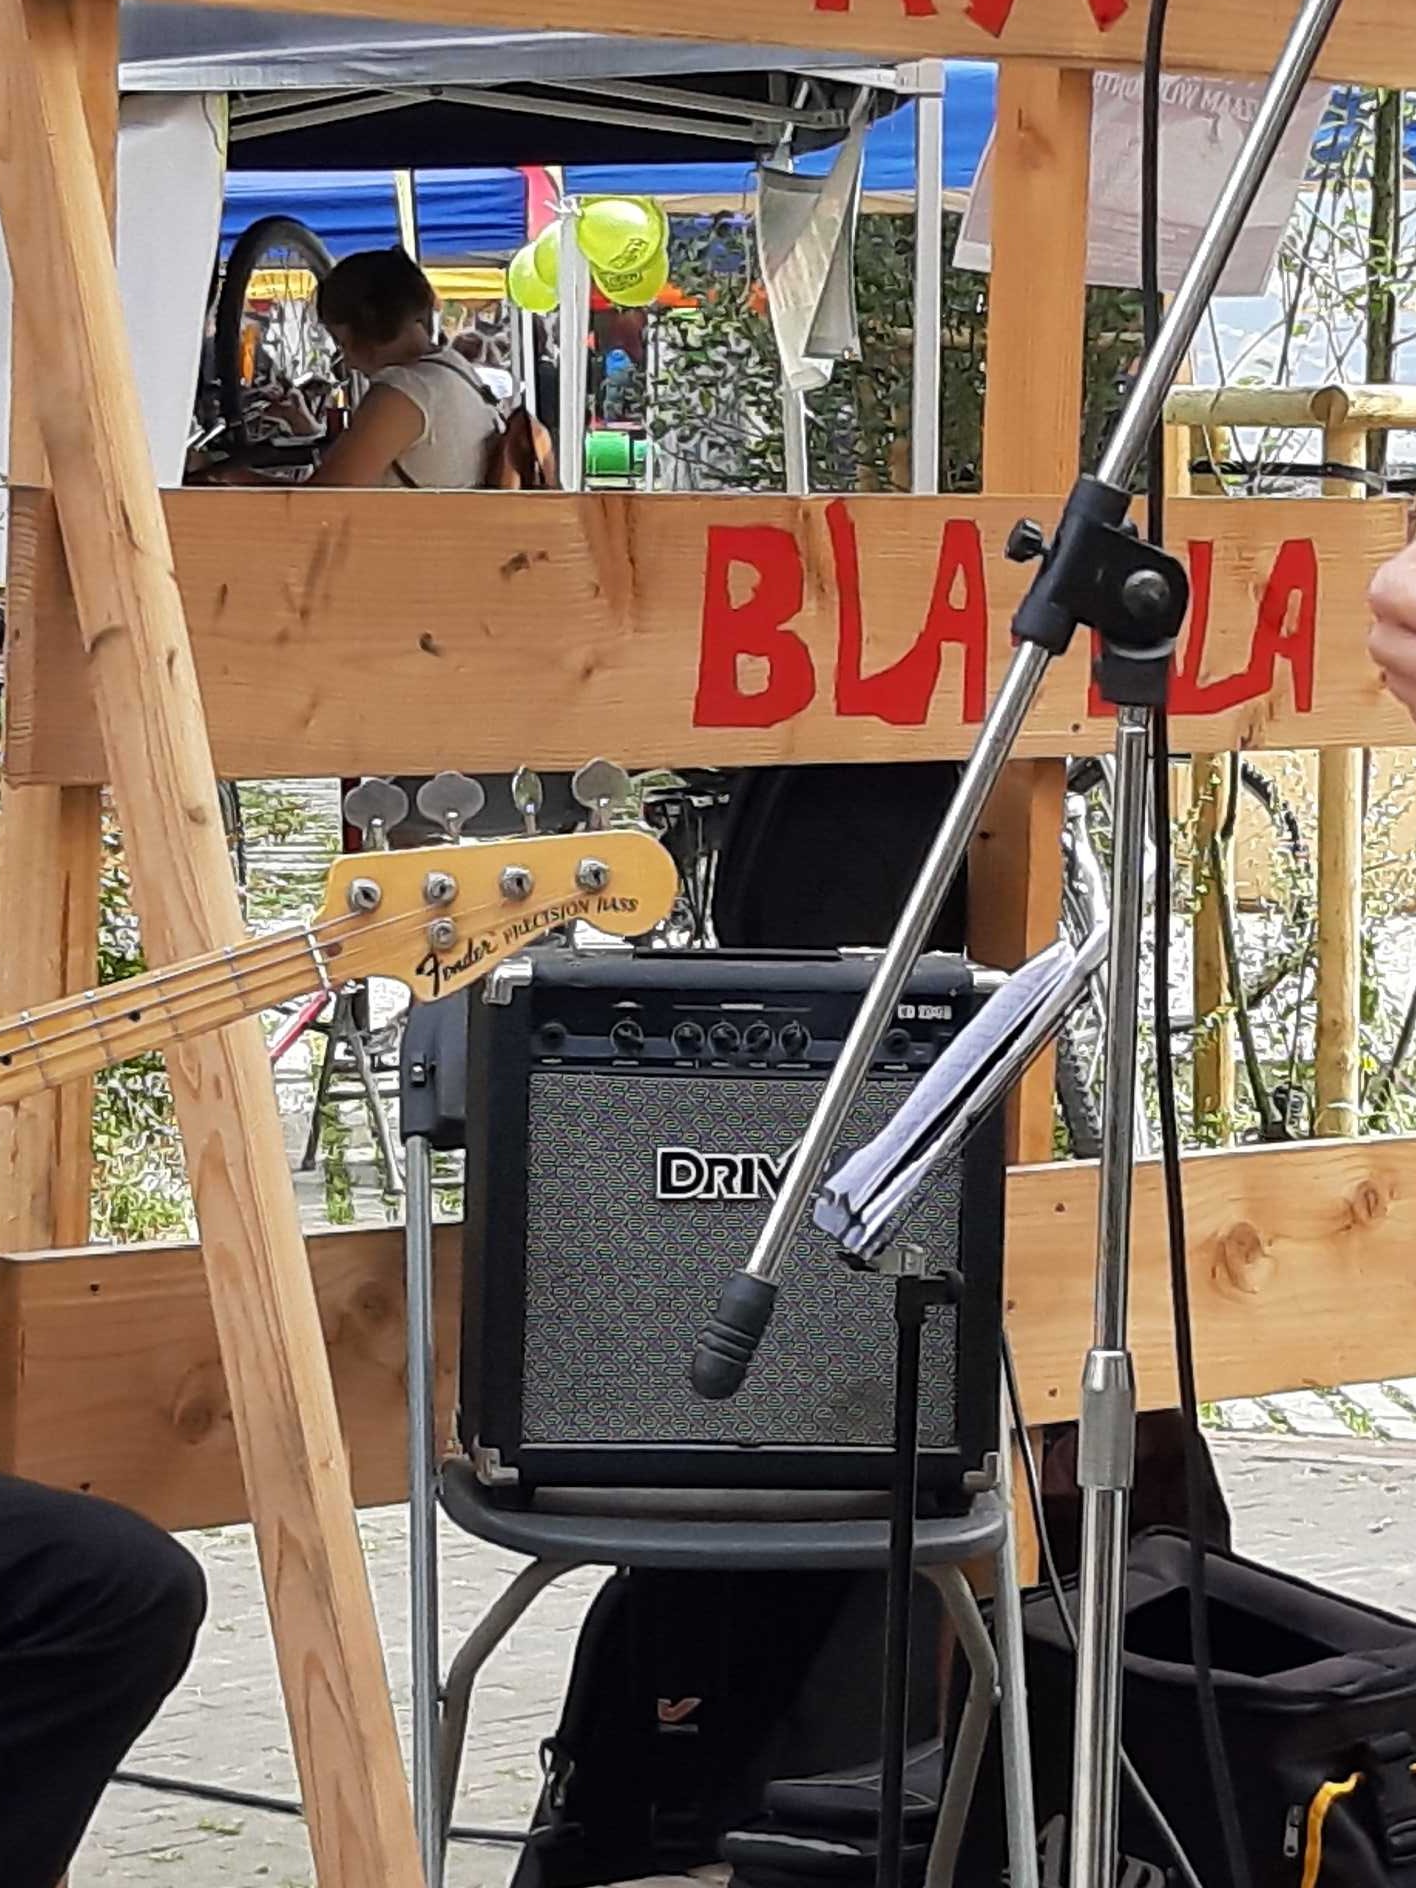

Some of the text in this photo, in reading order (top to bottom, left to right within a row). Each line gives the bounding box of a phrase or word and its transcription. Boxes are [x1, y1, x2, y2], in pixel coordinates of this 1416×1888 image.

[415, 896, 640, 998] Fender PRECISION BASS
[656, 1141, 802, 1201] DRIV
